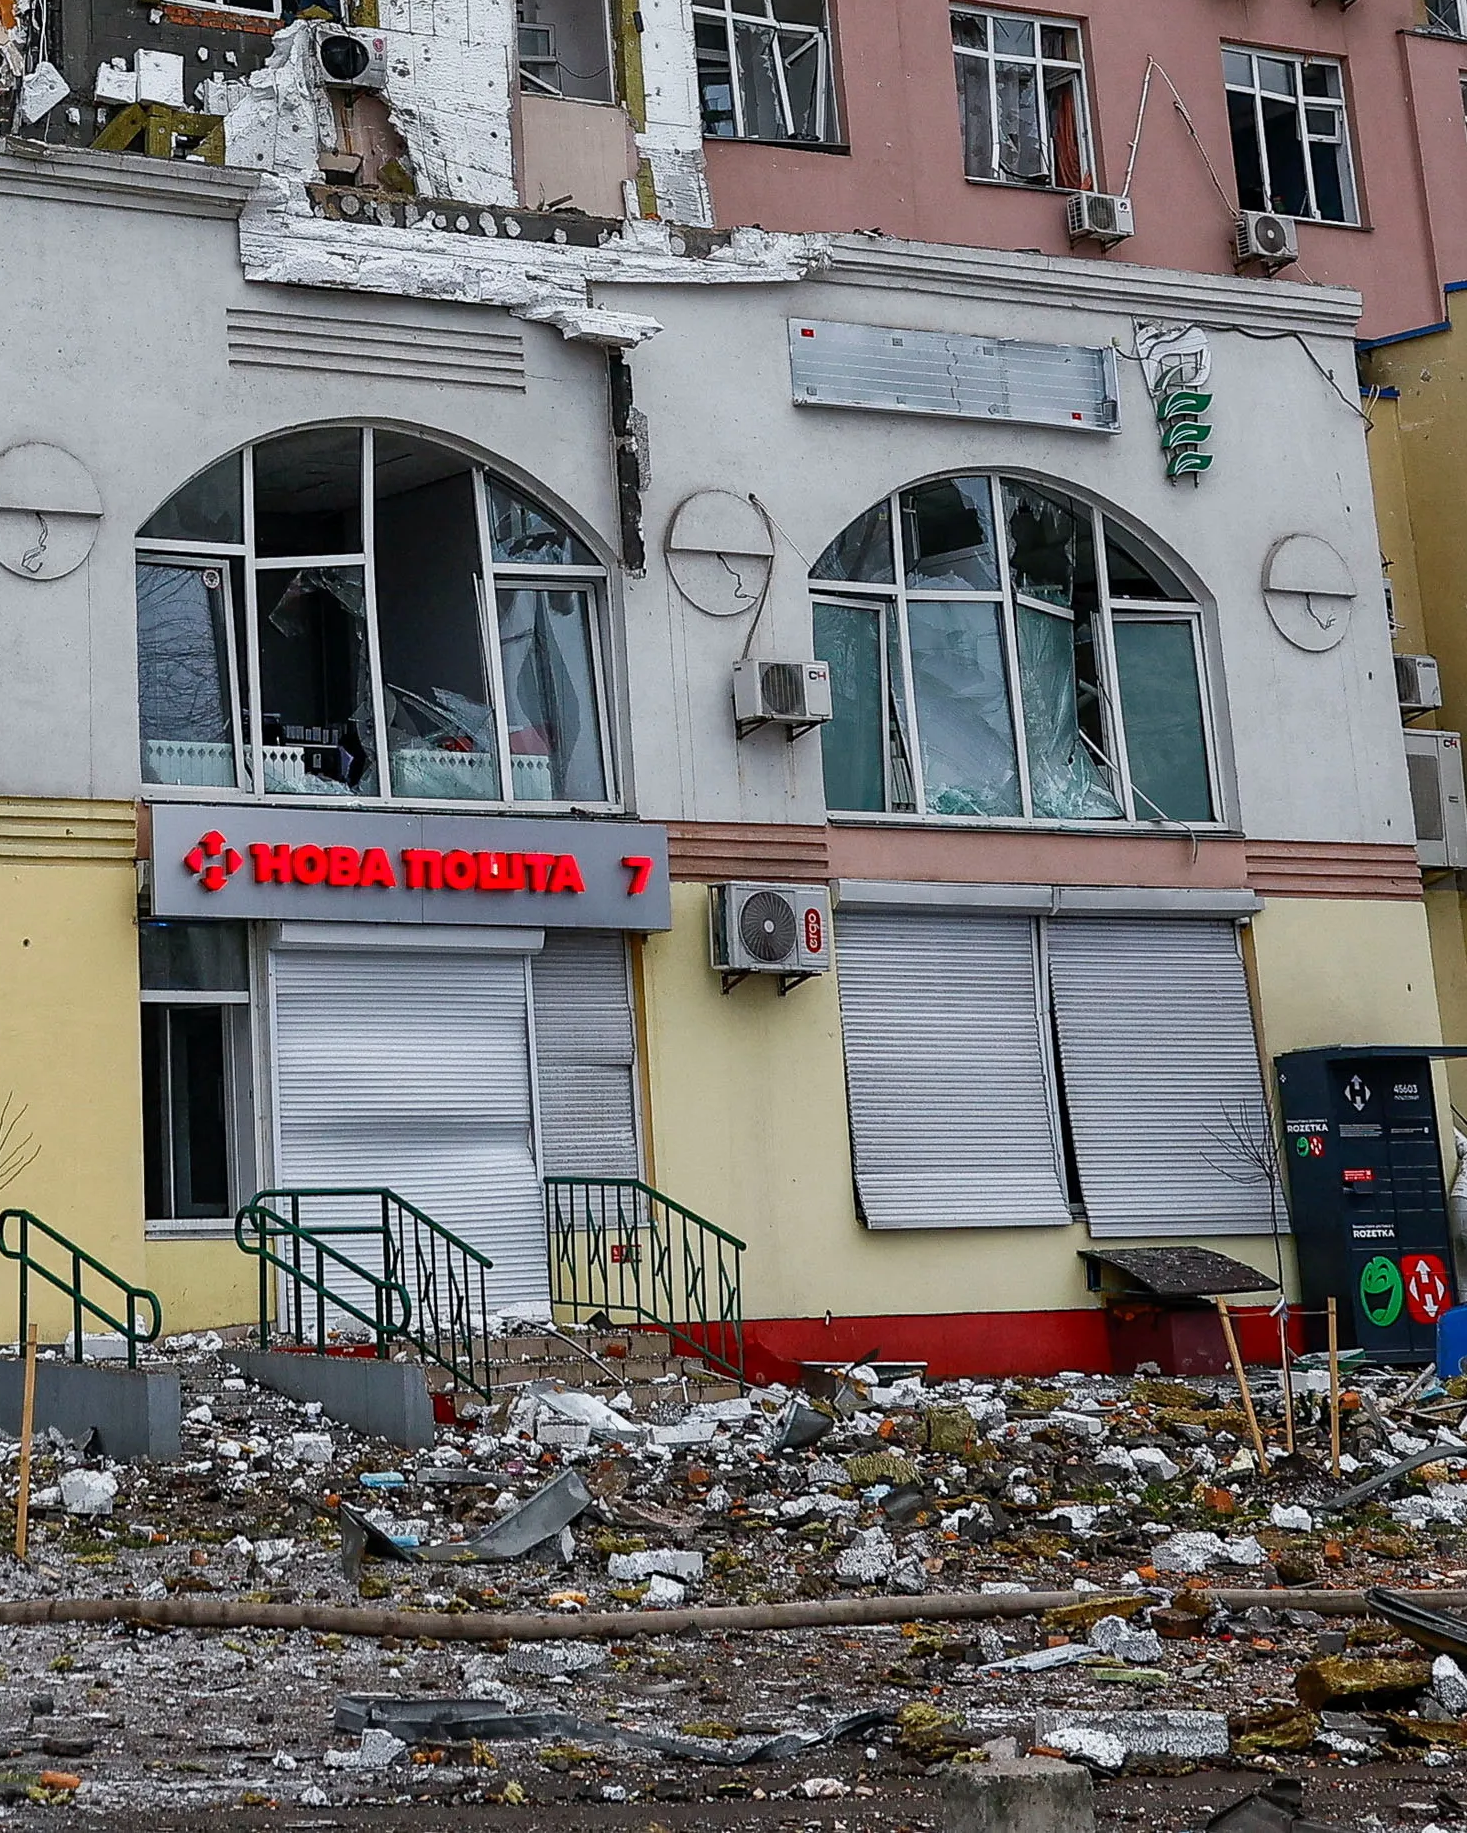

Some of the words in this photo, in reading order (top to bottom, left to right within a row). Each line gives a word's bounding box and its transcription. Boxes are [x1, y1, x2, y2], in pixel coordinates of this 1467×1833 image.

[808, 670, 827, 682] CH
[1443, 739, 1458, 749] CH
[247, 842, 397, 888] НОВА
[401, 847, 586, 894] ПОШТА
[621, 855, 654, 895] 7
[807, 912, 821, 949] ergo
[1286, 1123, 1329, 1134] ROZETKA
[1352, 1229, 1396, 1239] ROZETKA
